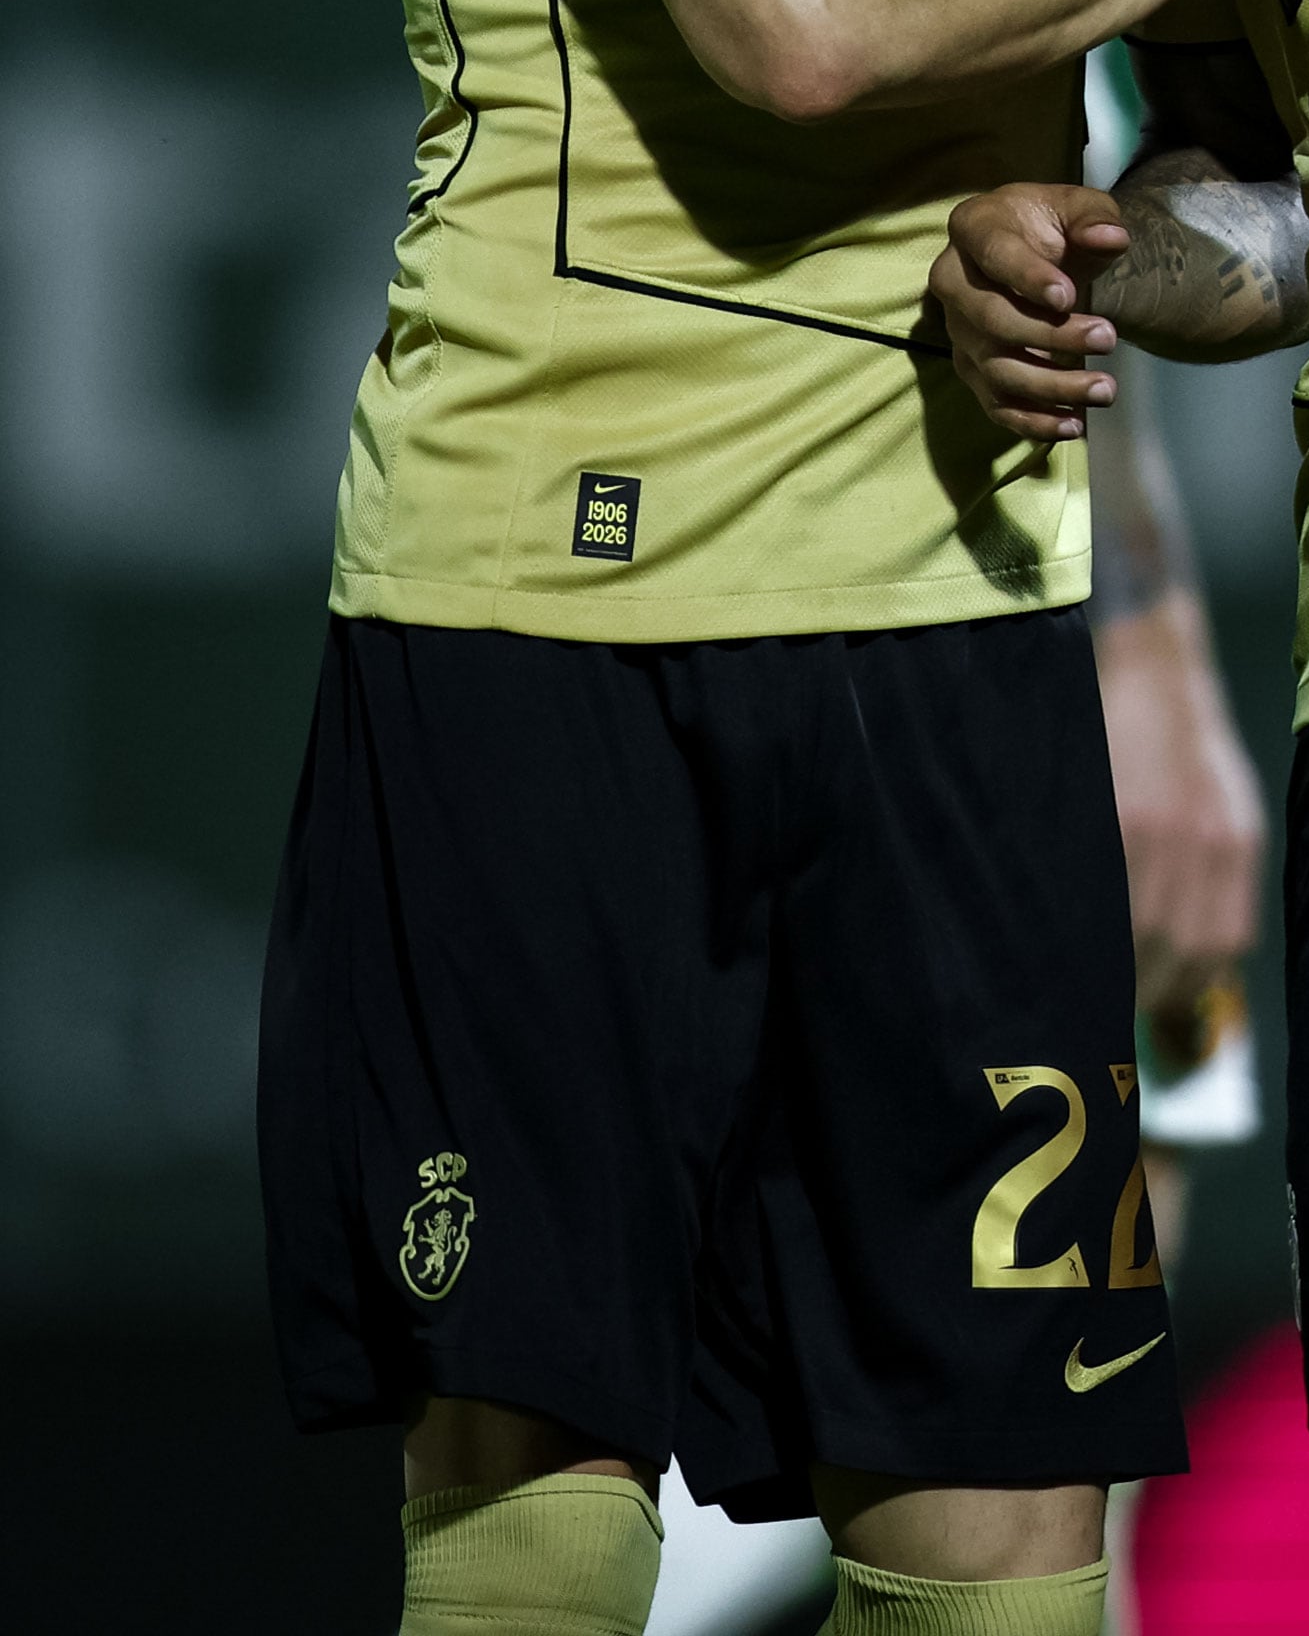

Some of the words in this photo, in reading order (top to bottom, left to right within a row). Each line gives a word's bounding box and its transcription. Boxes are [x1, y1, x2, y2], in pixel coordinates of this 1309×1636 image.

[587, 499, 628, 524] 1906
[581, 521, 627, 545] 2026
[418, 1151, 467, 1189] SCP
